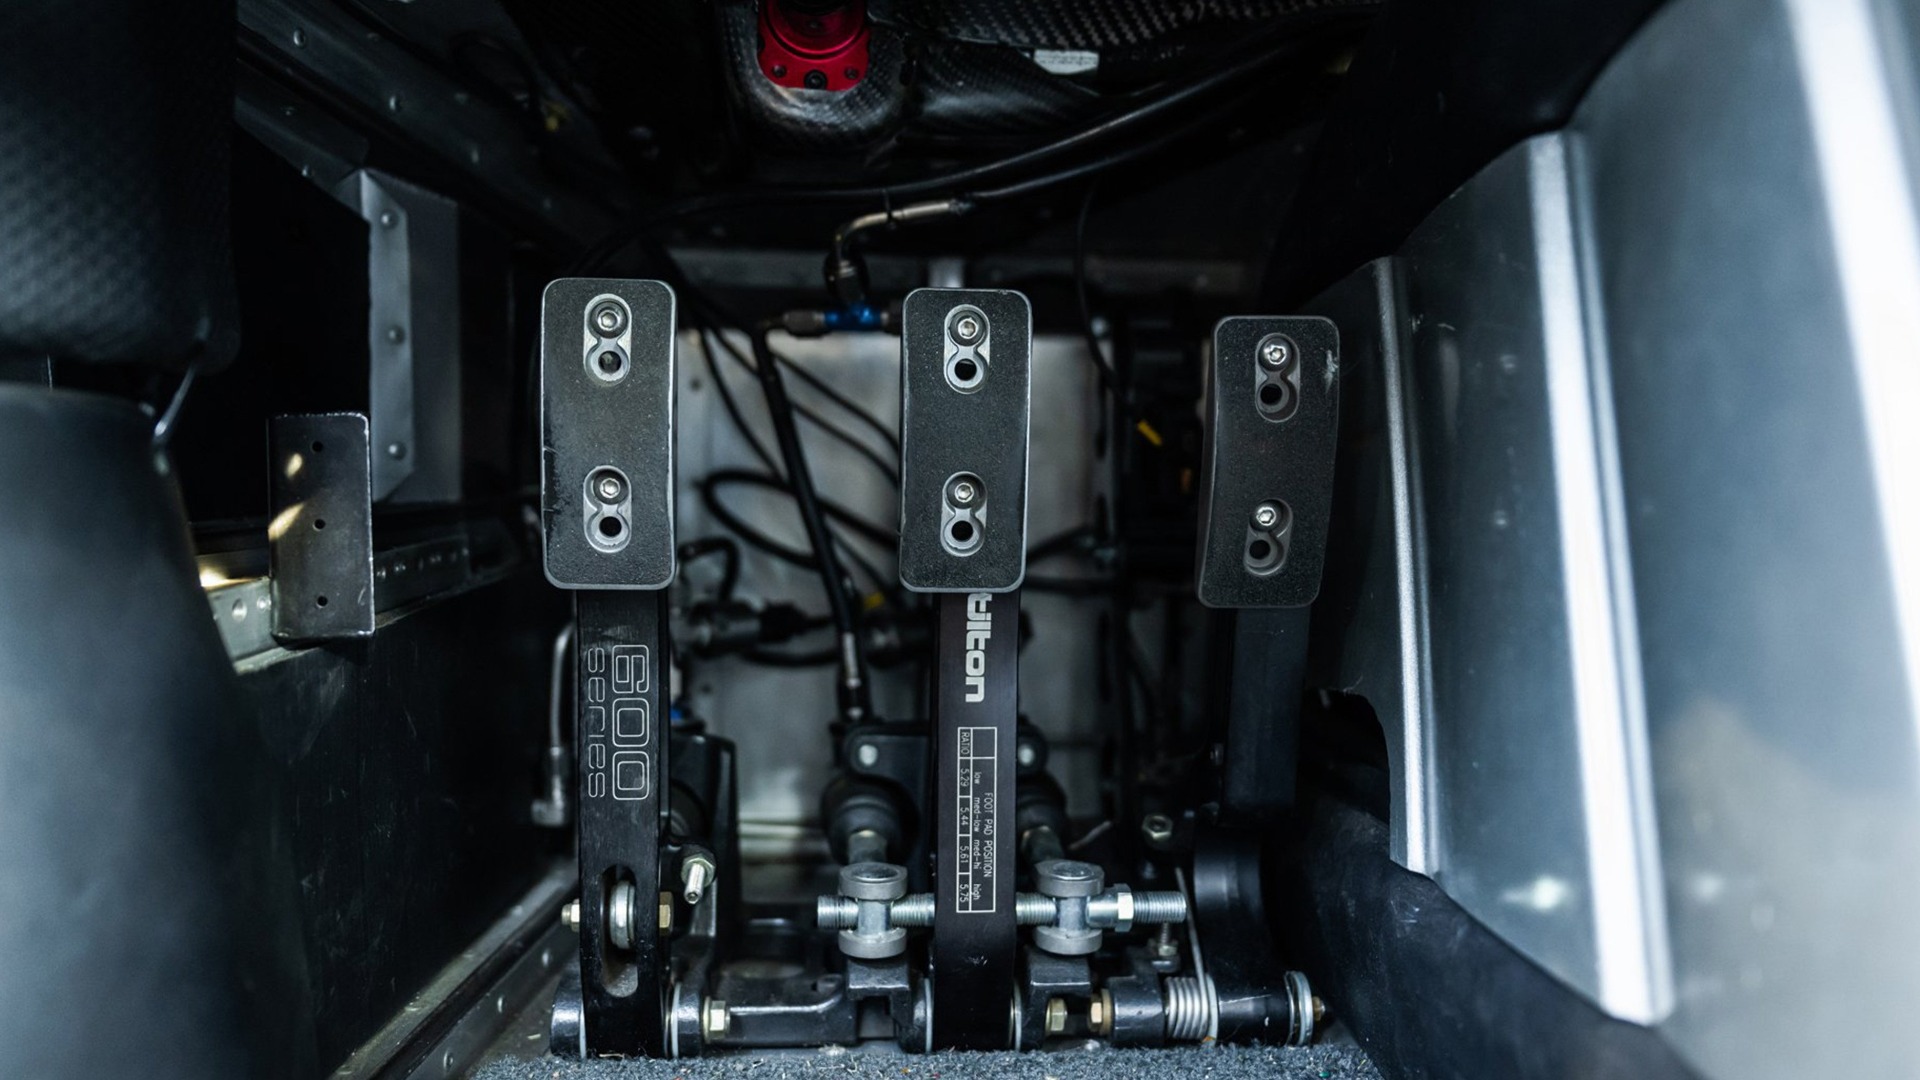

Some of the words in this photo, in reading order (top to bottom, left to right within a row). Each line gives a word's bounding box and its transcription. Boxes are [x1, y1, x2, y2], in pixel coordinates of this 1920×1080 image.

[965, 593, 992, 702] tilton
[588, 648, 605, 797] series
[612, 645, 649, 800] 600
[961, 732, 970, 755] RATIO
[960, 768, 969, 787] 5.29
[974, 771, 982, 784] low
[984, 792, 993, 813] FOOT
[960, 807, 969, 826] 5.44
[973, 797, 981, 832] med-low
[984, 819, 993, 835] PAD
[960, 845, 969, 863] 5.61
[973, 840, 981, 869] med-hi
[983, 840, 993, 877] POSITION
[960, 884, 969, 903] 5.75
[972, 884, 981, 900] high
